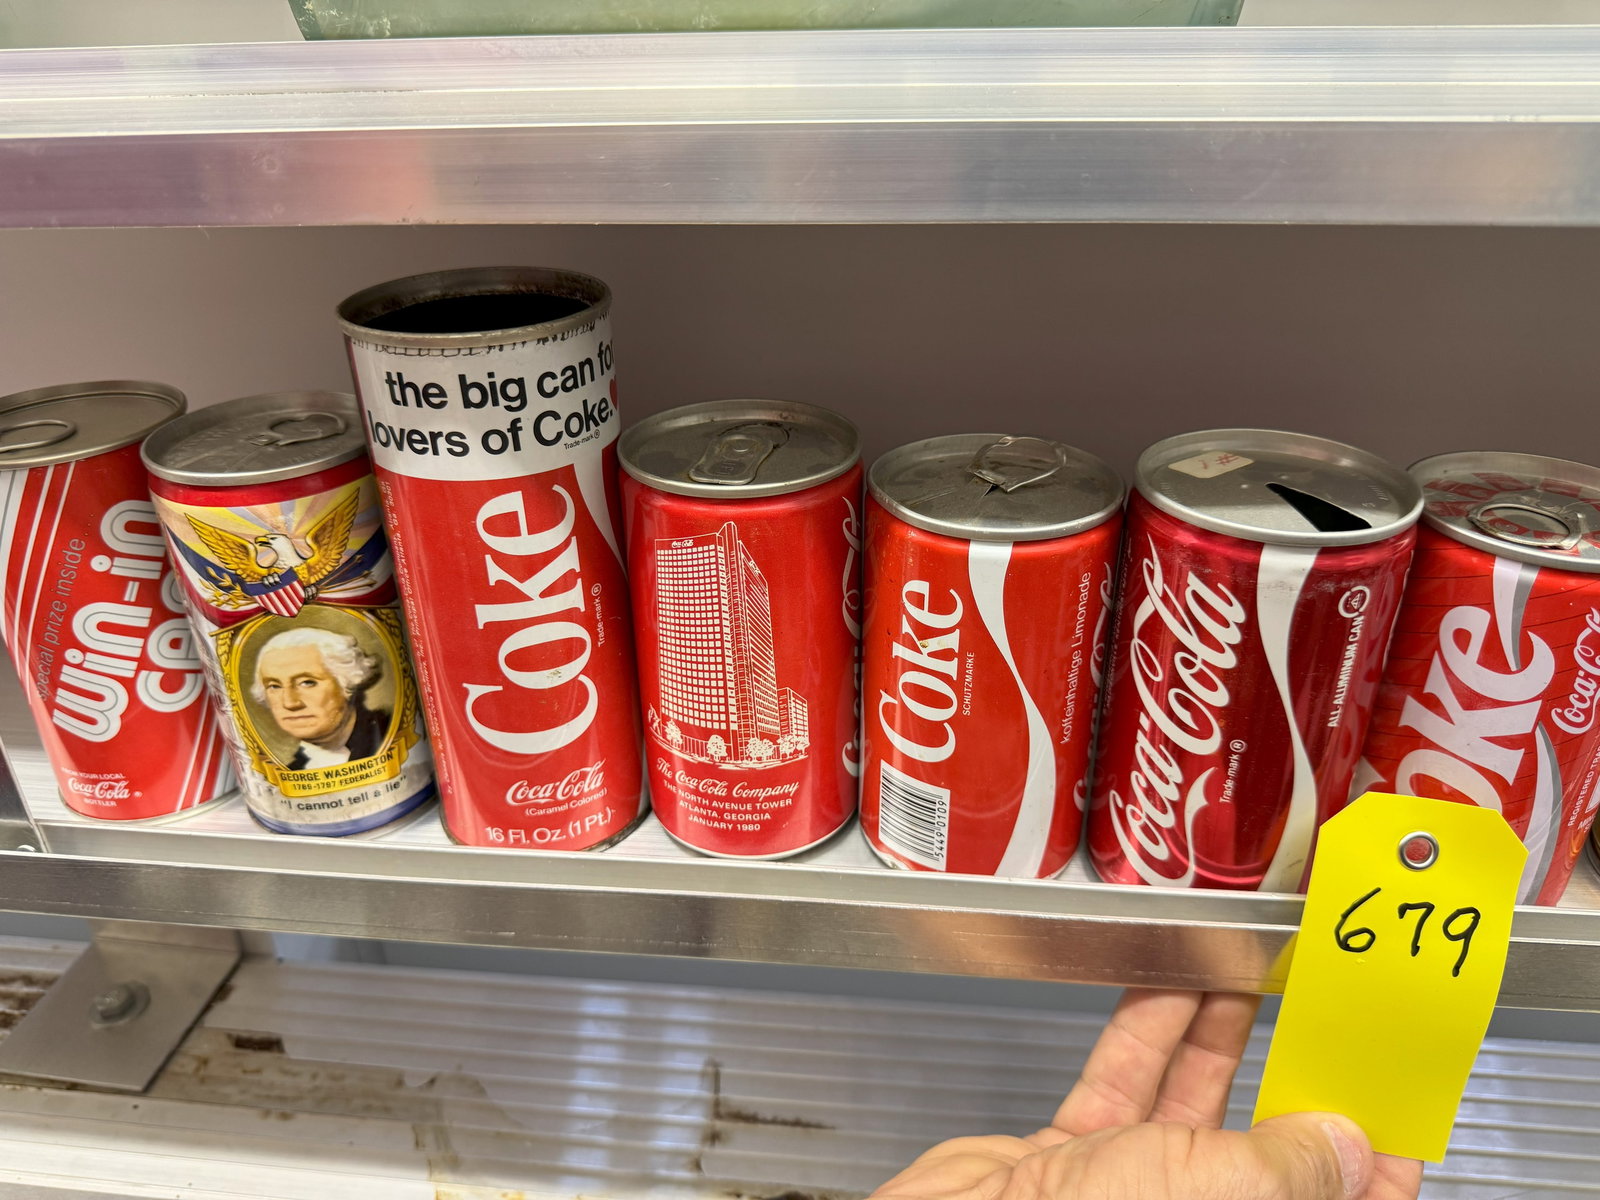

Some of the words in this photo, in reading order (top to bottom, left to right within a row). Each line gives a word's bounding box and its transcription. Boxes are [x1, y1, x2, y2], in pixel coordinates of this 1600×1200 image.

[385, 371, 448, 409] the
[458, 371, 528, 412] big
[537, 357, 596, 399] can
[367, 410, 470, 457] lovers
[481, 417, 523, 455] of
[533, 397, 613, 447] Coke.
[44, 599, 68, 646] prize
[136, 568, 207, 713] ca
[462, 484, 598, 754] Coke
[1348, 616, 1365, 642] CAN
[36, 645, 56, 701] special
[878, 578, 965, 763] Coke
[1060, 649, 1082, 745] koffeinhaltige
[1071, 572, 1091, 649] Limonade
[962, 651, 975, 716] SCHUTZMARKE
[1109, 533, 1246, 888] Coca-Cola
[1349, 606, 1556, 816] oke
[68, 777, 131, 799] Coca-Cola
[280, 772, 320, 782] GEORGE
[323, 751, 394, 779] WASHINGTON
[339, 766, 387, 787] FEDERALIST
[506, 758, 606, 806] Coca-Cola
[657, 757, 673, 779] The
[674, 770, 728, 796] Coca-Cola
[732, 781, 800, 801] Company
[297, 799, 345, 811] cannot
[348, 792, 369, 807] tell
[373, 789, 382, 798] a
[525, 803, 569, 816] (Caramel
[569, 788, 607, 808] Colored)
[663, 780, 677, 793] THE
[677, 789, 709, 806] NORTH
[712, 801, 753, 810] AVENUE
[755, 798, 793, 810] TOWER
[724, 812, 771, 821] GEORGIA
[1568, 770, 1595, 827] REGISTERED
[485, 827, 505, 843] 16
[533, 827, 567, 844] Oz.
[568, 820, 581, 837] (1
[688, 815, 734, 830] JANUARY
[736, 823, 761, 831] 1980
[1334, 887, 1481, 977] 679
